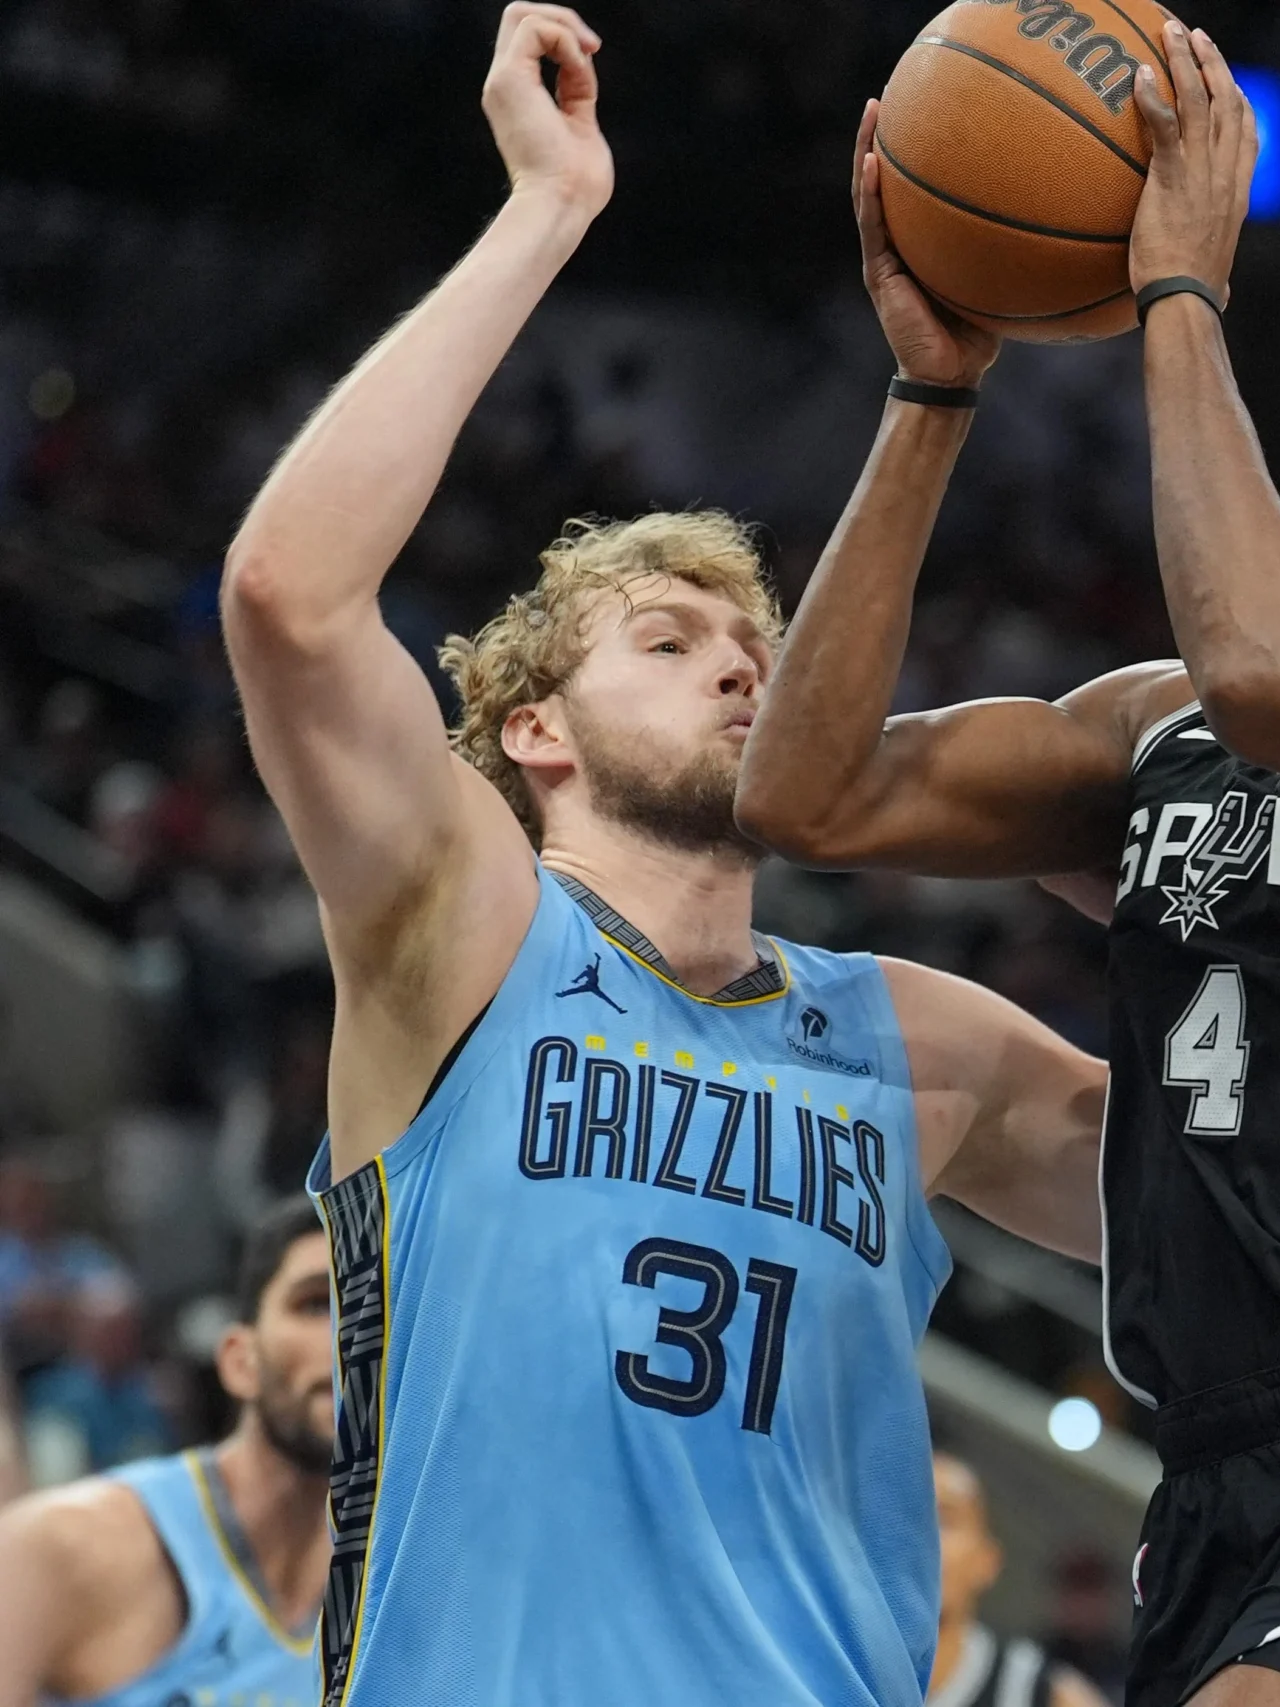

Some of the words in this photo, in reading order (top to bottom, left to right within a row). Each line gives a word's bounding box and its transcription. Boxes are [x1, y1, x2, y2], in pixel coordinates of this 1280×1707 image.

[786, 1037, 872, 1076] Robinhood
[1162, 964, 1251, 1136] 4
[519, 1035, 887, 1268] GRIZZLIES
[615, 1236, 798, 1435] 31
